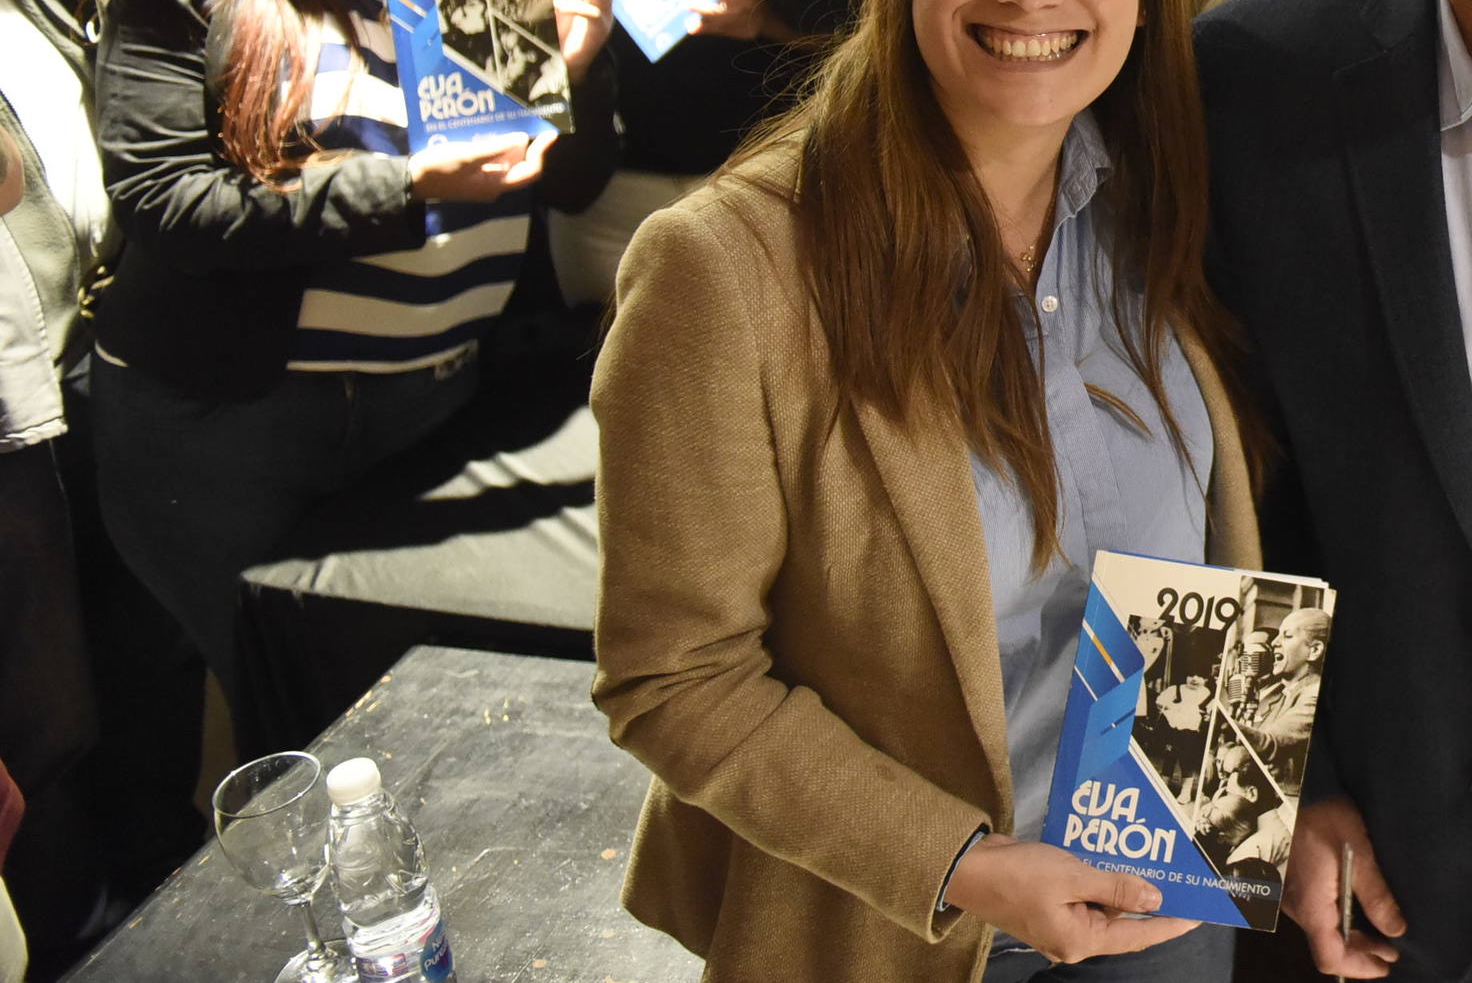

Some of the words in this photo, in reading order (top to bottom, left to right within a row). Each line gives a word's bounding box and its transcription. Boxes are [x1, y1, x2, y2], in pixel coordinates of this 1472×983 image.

[418, 71, 464, 100] EVA
[420, 88, 496, 122] PERÓN
[1157, 587, 1240, 632] 2019
[1071, 780, 1140, 823] EVA
[1063, 814, 1177, 864] PERÓN
[1168, 871, 1183, 883] DE
[1185, 874, 1200, 886] SU
[1202, 877, 1271, 897] NACIMIENTO
